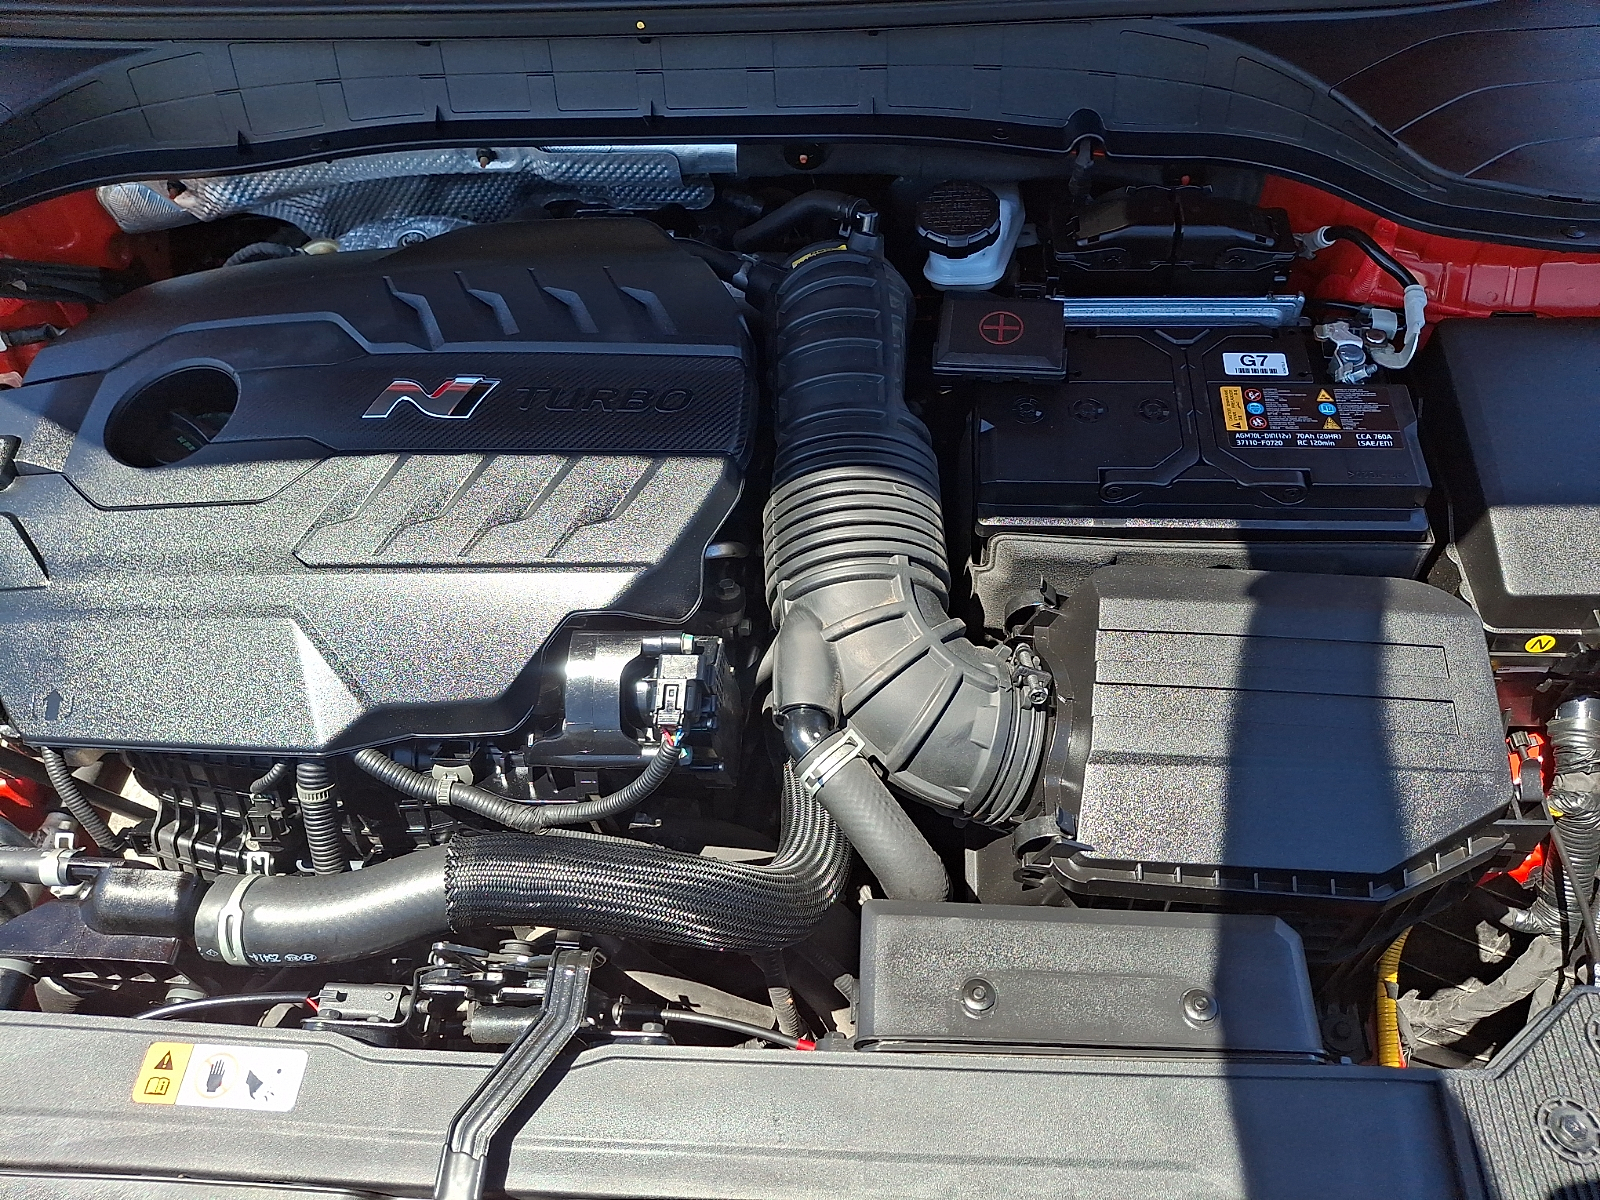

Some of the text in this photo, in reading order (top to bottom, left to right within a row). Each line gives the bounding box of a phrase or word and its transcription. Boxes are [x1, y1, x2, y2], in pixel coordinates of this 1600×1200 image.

[1239, 354, 1269, 366] G7
[516, 385, 695, 413] TURBO
[1530, 638, 1552, 650] N
